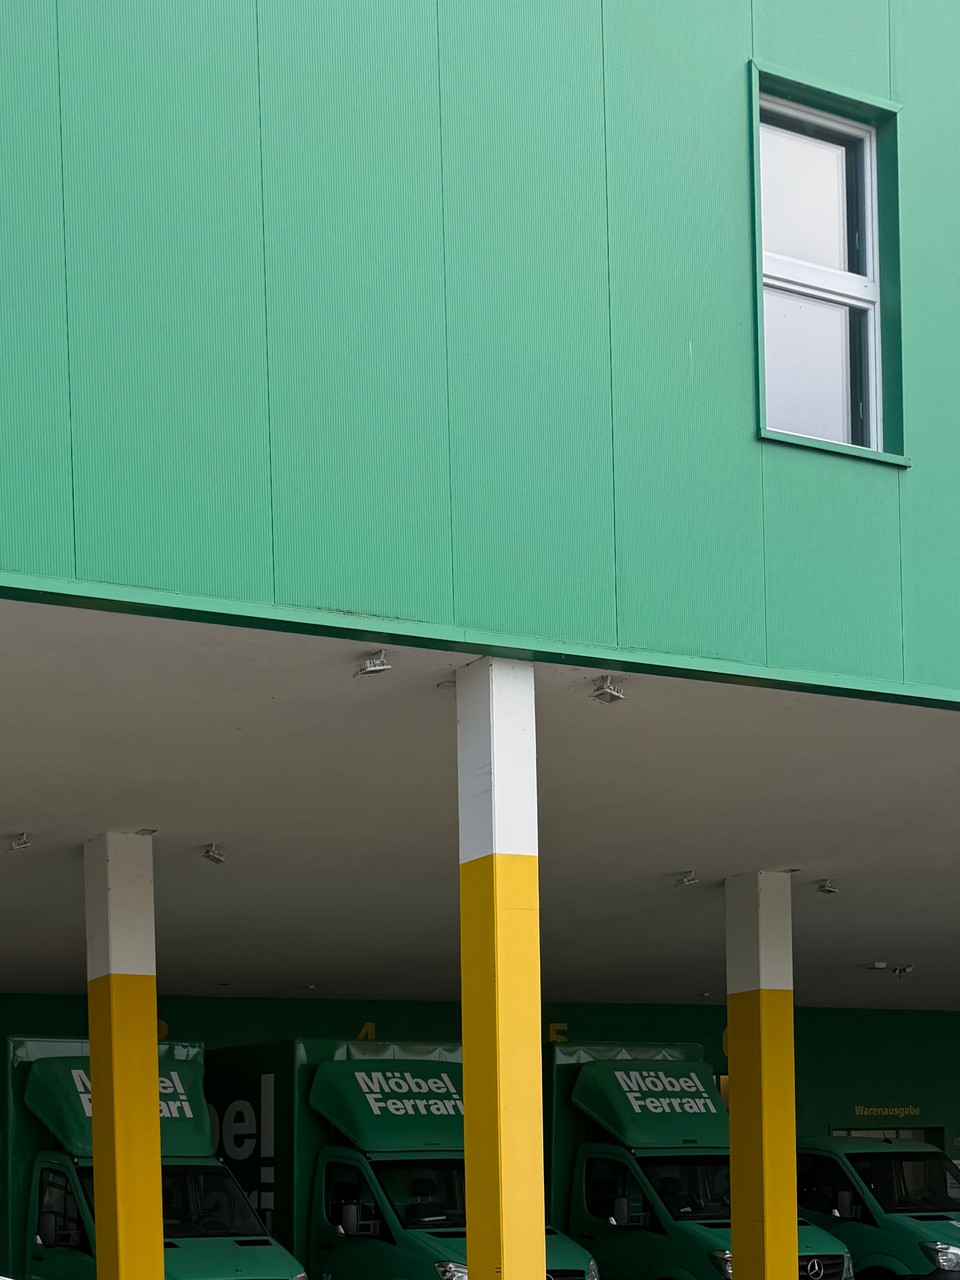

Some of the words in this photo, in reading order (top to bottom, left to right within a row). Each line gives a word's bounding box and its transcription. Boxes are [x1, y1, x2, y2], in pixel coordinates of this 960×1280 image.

[354, 1071, 457, 1094] Möbel
[614, 1070, 706, 1093] Möbel
[364, 1093, 465, 1116] Ferrari
[625, 1091, 718, 1114] Ferrari
[855, 1105, 921, 1117] Warenausgabe
